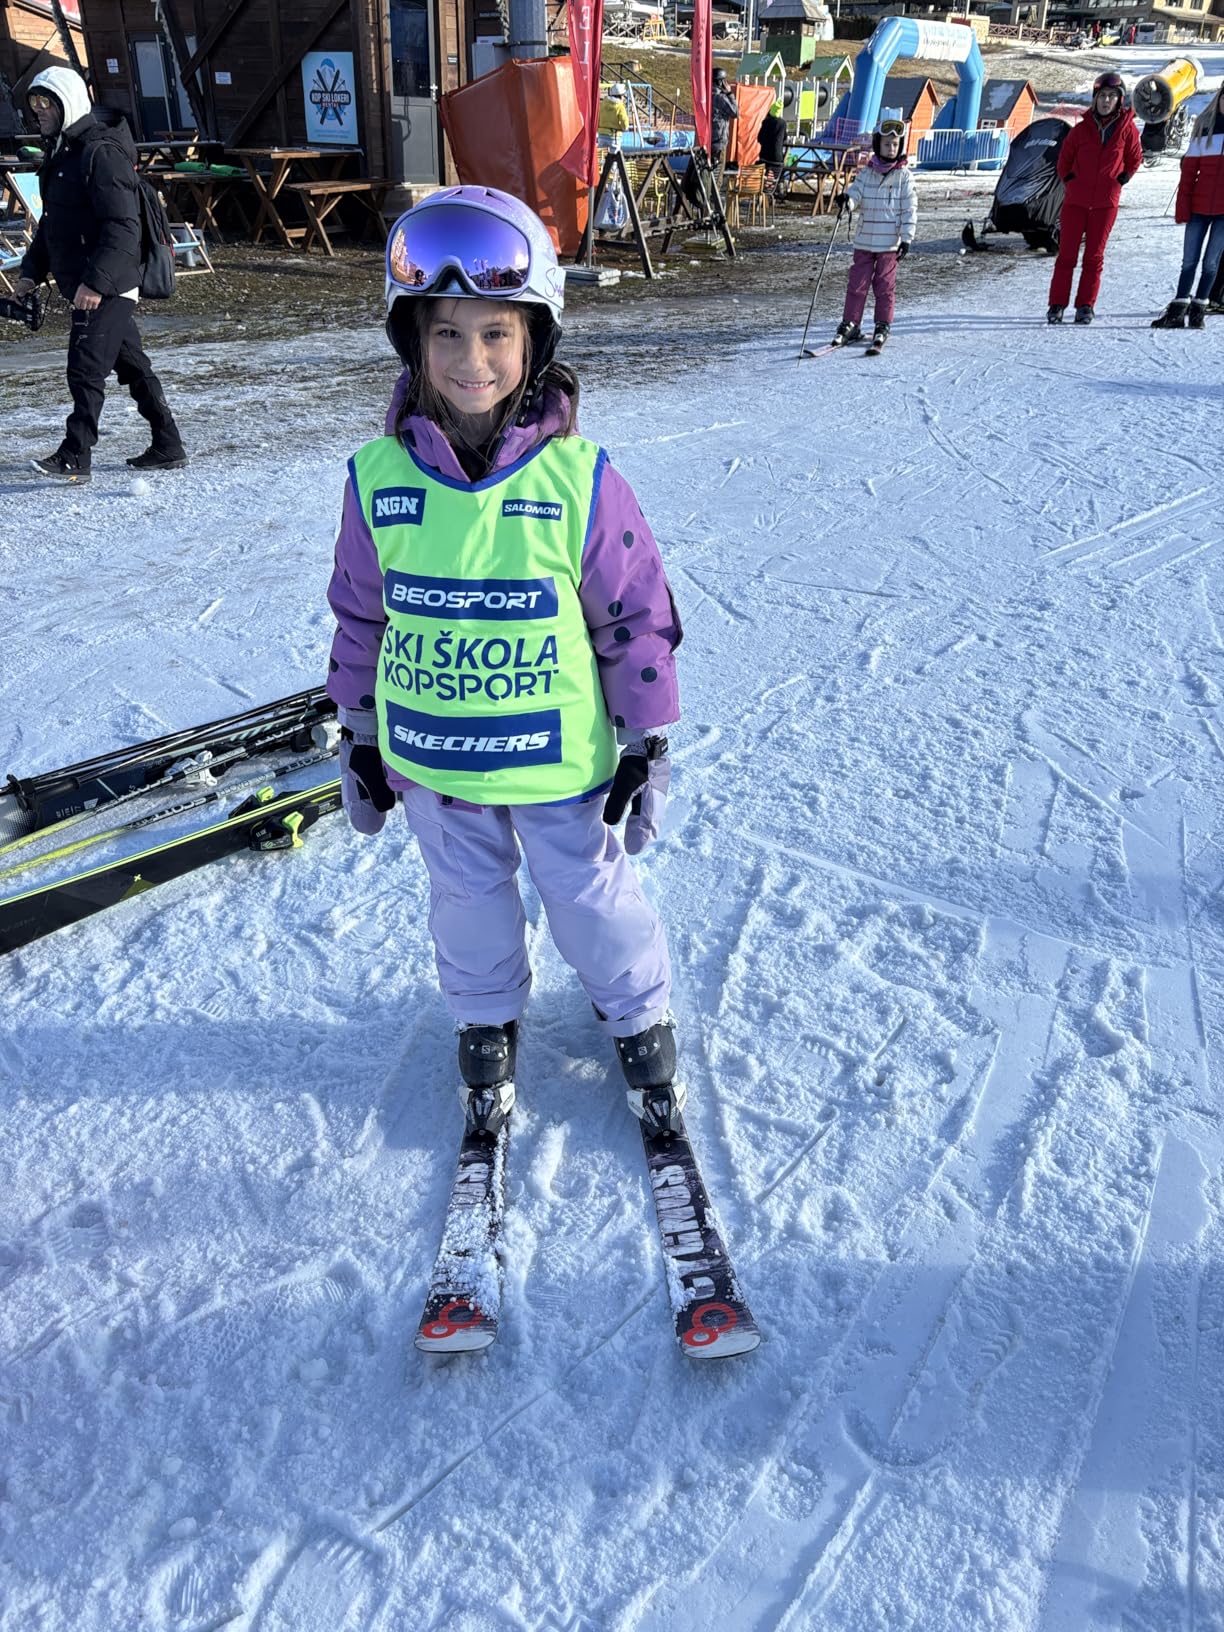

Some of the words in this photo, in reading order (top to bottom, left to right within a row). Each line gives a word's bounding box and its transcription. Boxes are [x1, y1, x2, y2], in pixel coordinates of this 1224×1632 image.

[376, 496, 419, 517] NGN
[504, 503, 561, 516] SALOMON
[392, 583, 542, 609] BEOSPORT
[384, 625, 424, 664] SKI
[432, 630, 558, 670] ŠKOLA
[384, 656, 559, 701] KOPSPORT
[394, 724, 551, 752] SKECHERS
[153, 797, 207, 822] SCOTT
